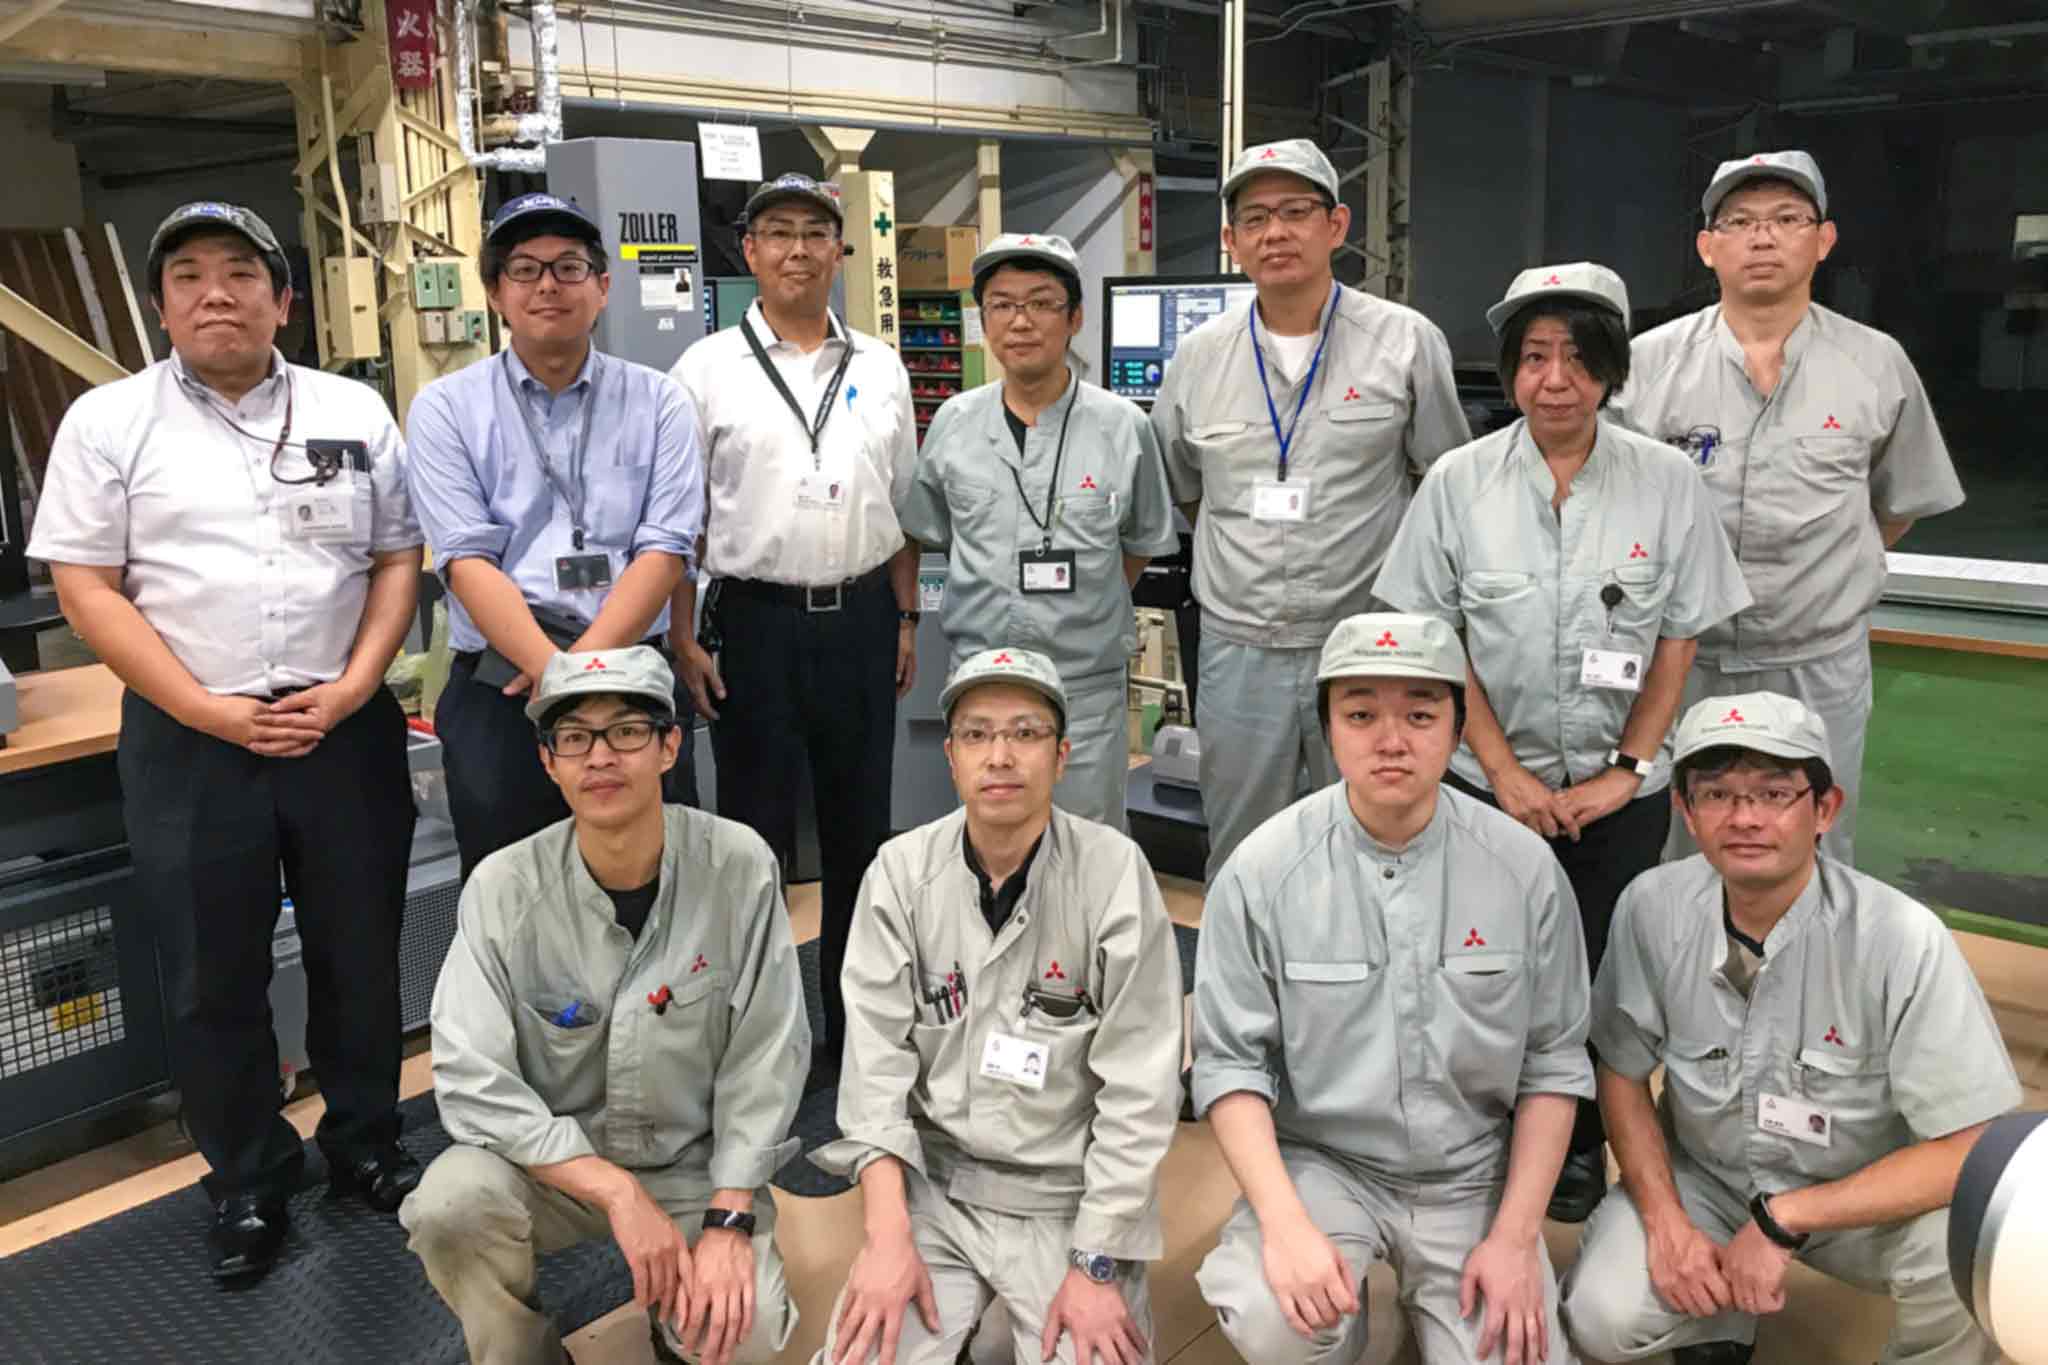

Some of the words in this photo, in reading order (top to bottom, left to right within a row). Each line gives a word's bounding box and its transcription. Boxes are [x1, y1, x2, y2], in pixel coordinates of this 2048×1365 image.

[618, 212, 679, 243] ZOLLER
[877, 257, 895, 349] 救急用
